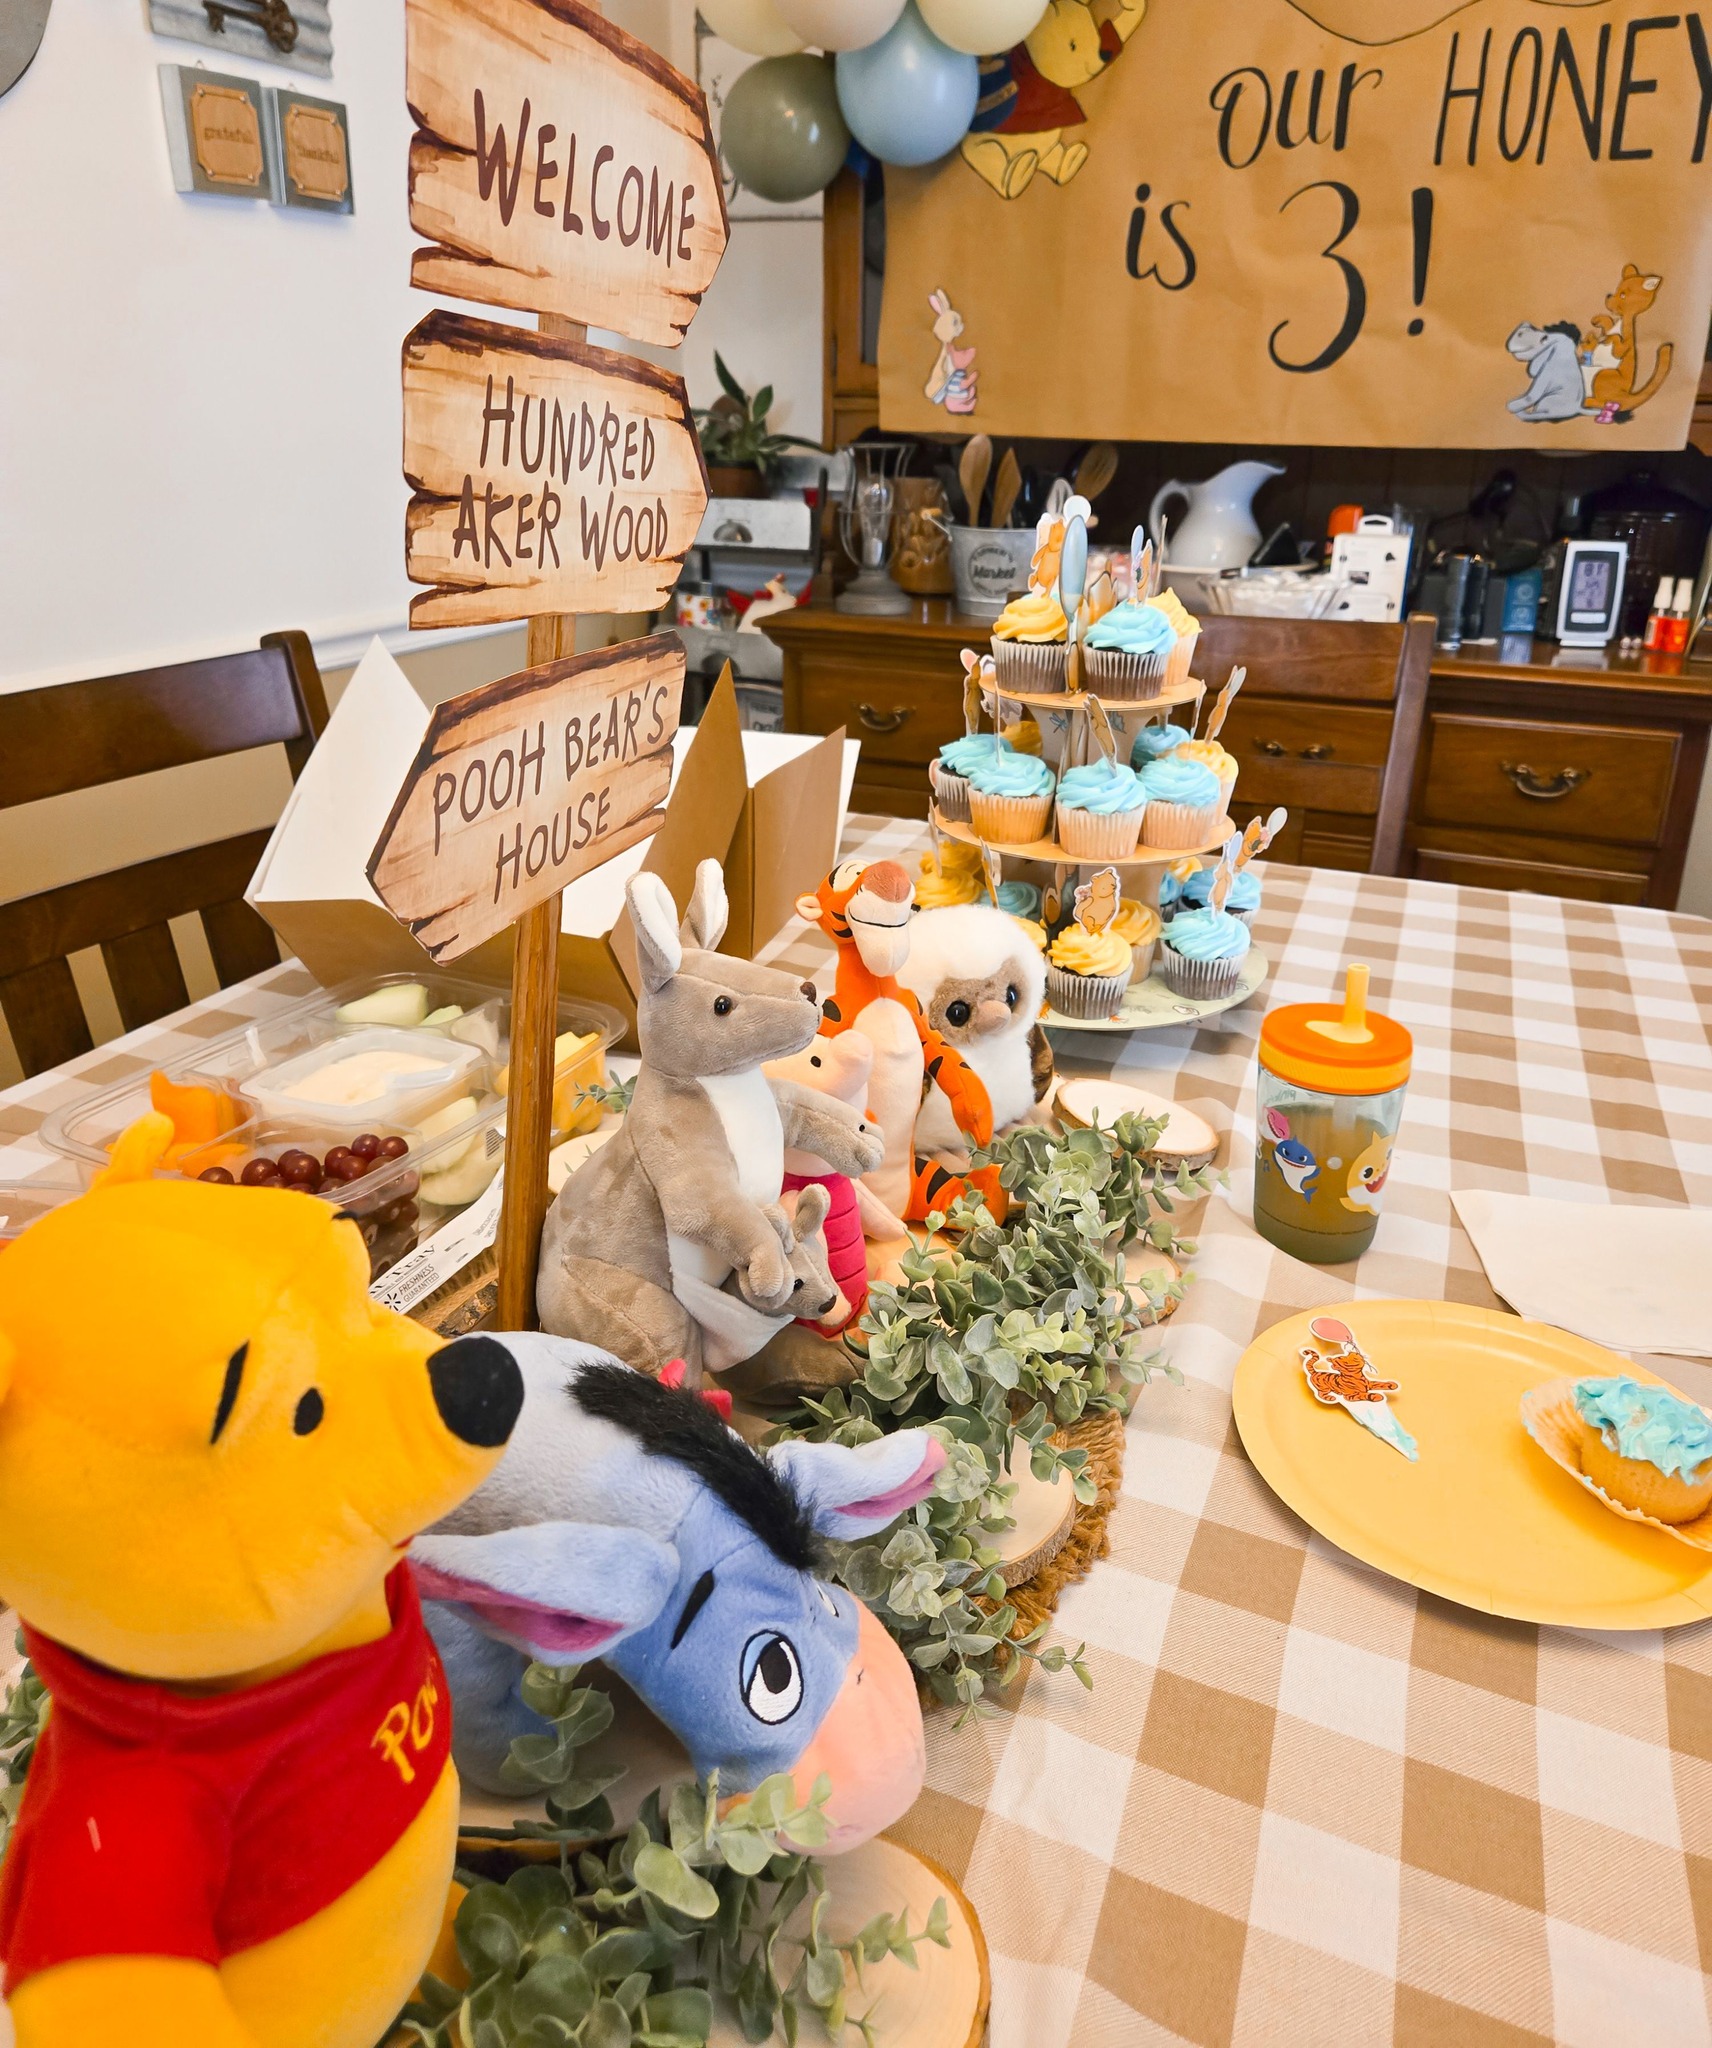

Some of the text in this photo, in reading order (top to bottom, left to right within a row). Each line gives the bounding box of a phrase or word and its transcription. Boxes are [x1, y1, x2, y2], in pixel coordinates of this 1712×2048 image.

[1209, 62, 1383, 169] our
[474, 88, 695, 268] WELCOME
[1125, 183, 1197, 291] is
[479, 373, 655, 487] HUNDRED
[452, 474, 668, 572] AKER WOOD
[433, 680, 668, 857] POOH BEAR'S
[493, 786, 611, 904] HOUSE
[386, 1244, 435, 1279] Tray
[399, 1263, 435, 1295] FRESHNESS
[403, 1272, 440, 1302] GUARANTEED
